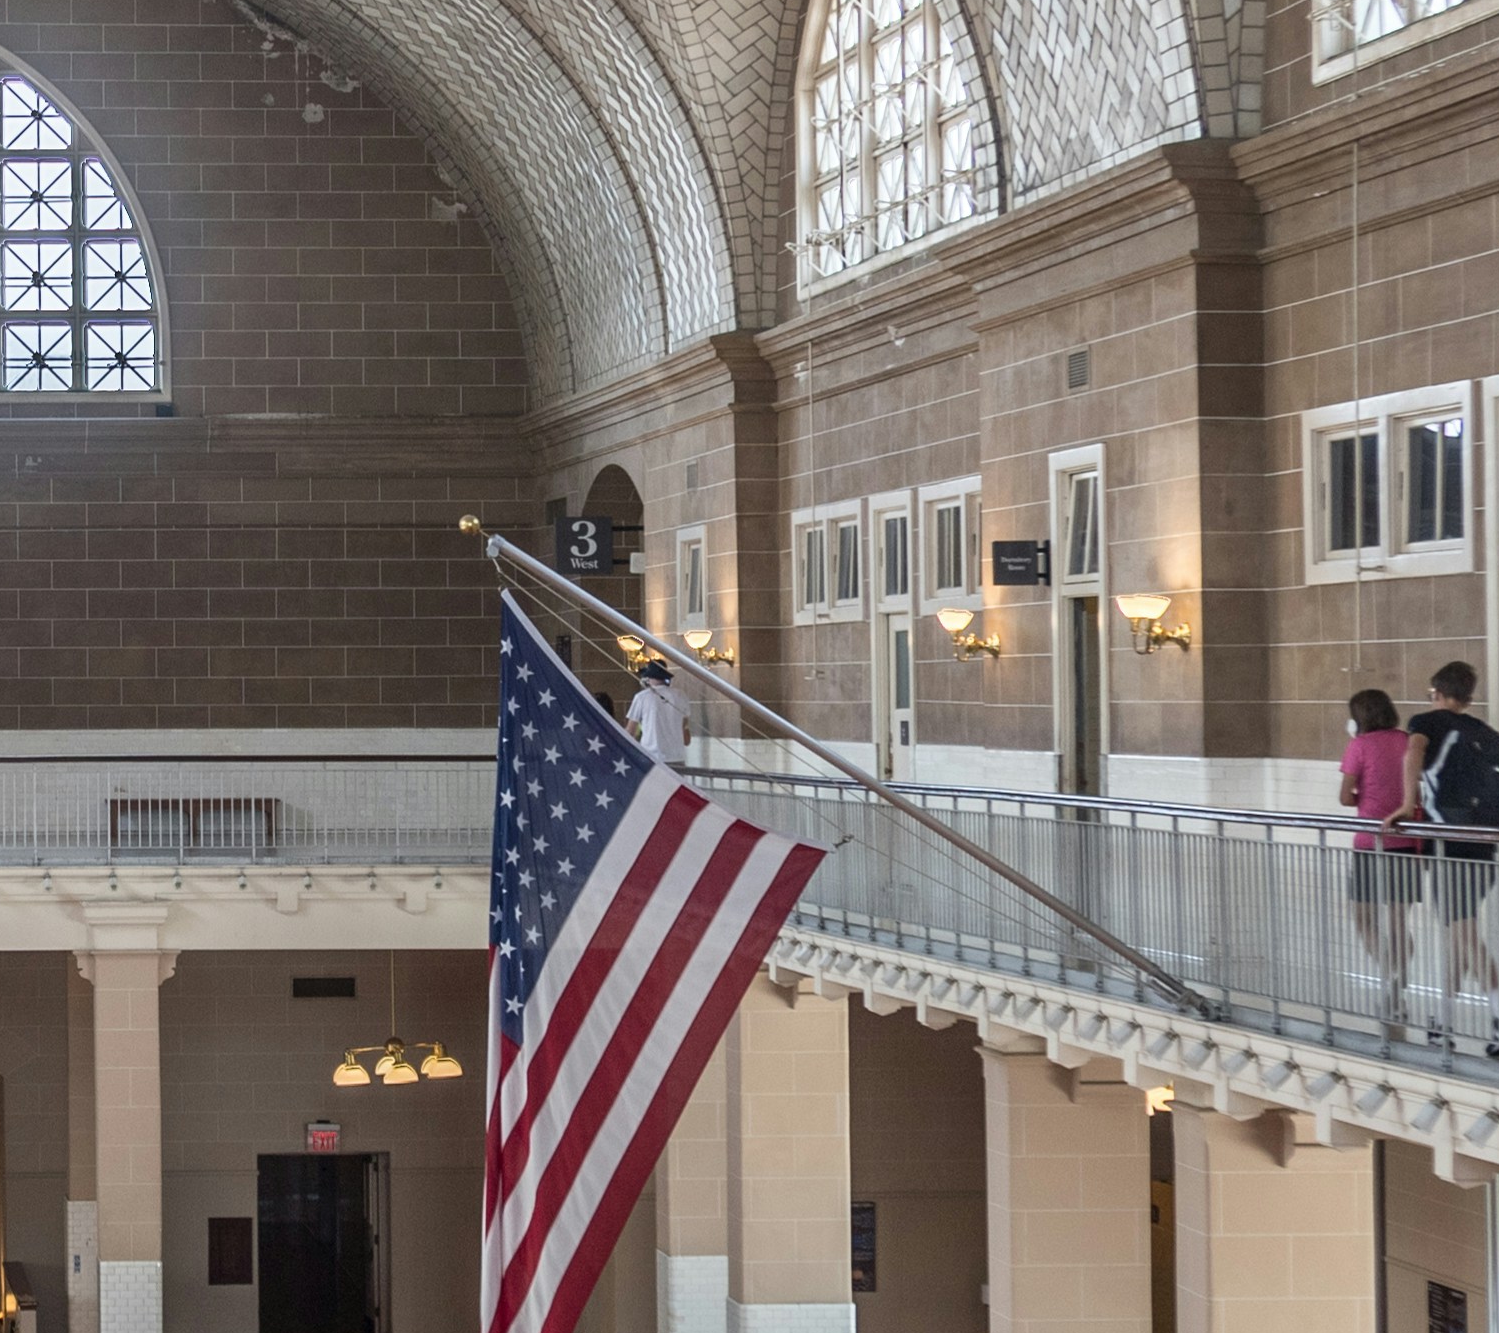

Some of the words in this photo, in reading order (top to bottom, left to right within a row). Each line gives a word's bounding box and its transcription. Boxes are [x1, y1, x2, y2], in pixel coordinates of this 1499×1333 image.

[570, 520, 598, 557] 3
[570, 557, 599, 569] West
[313, 1131, 337, 1151] EXIT
